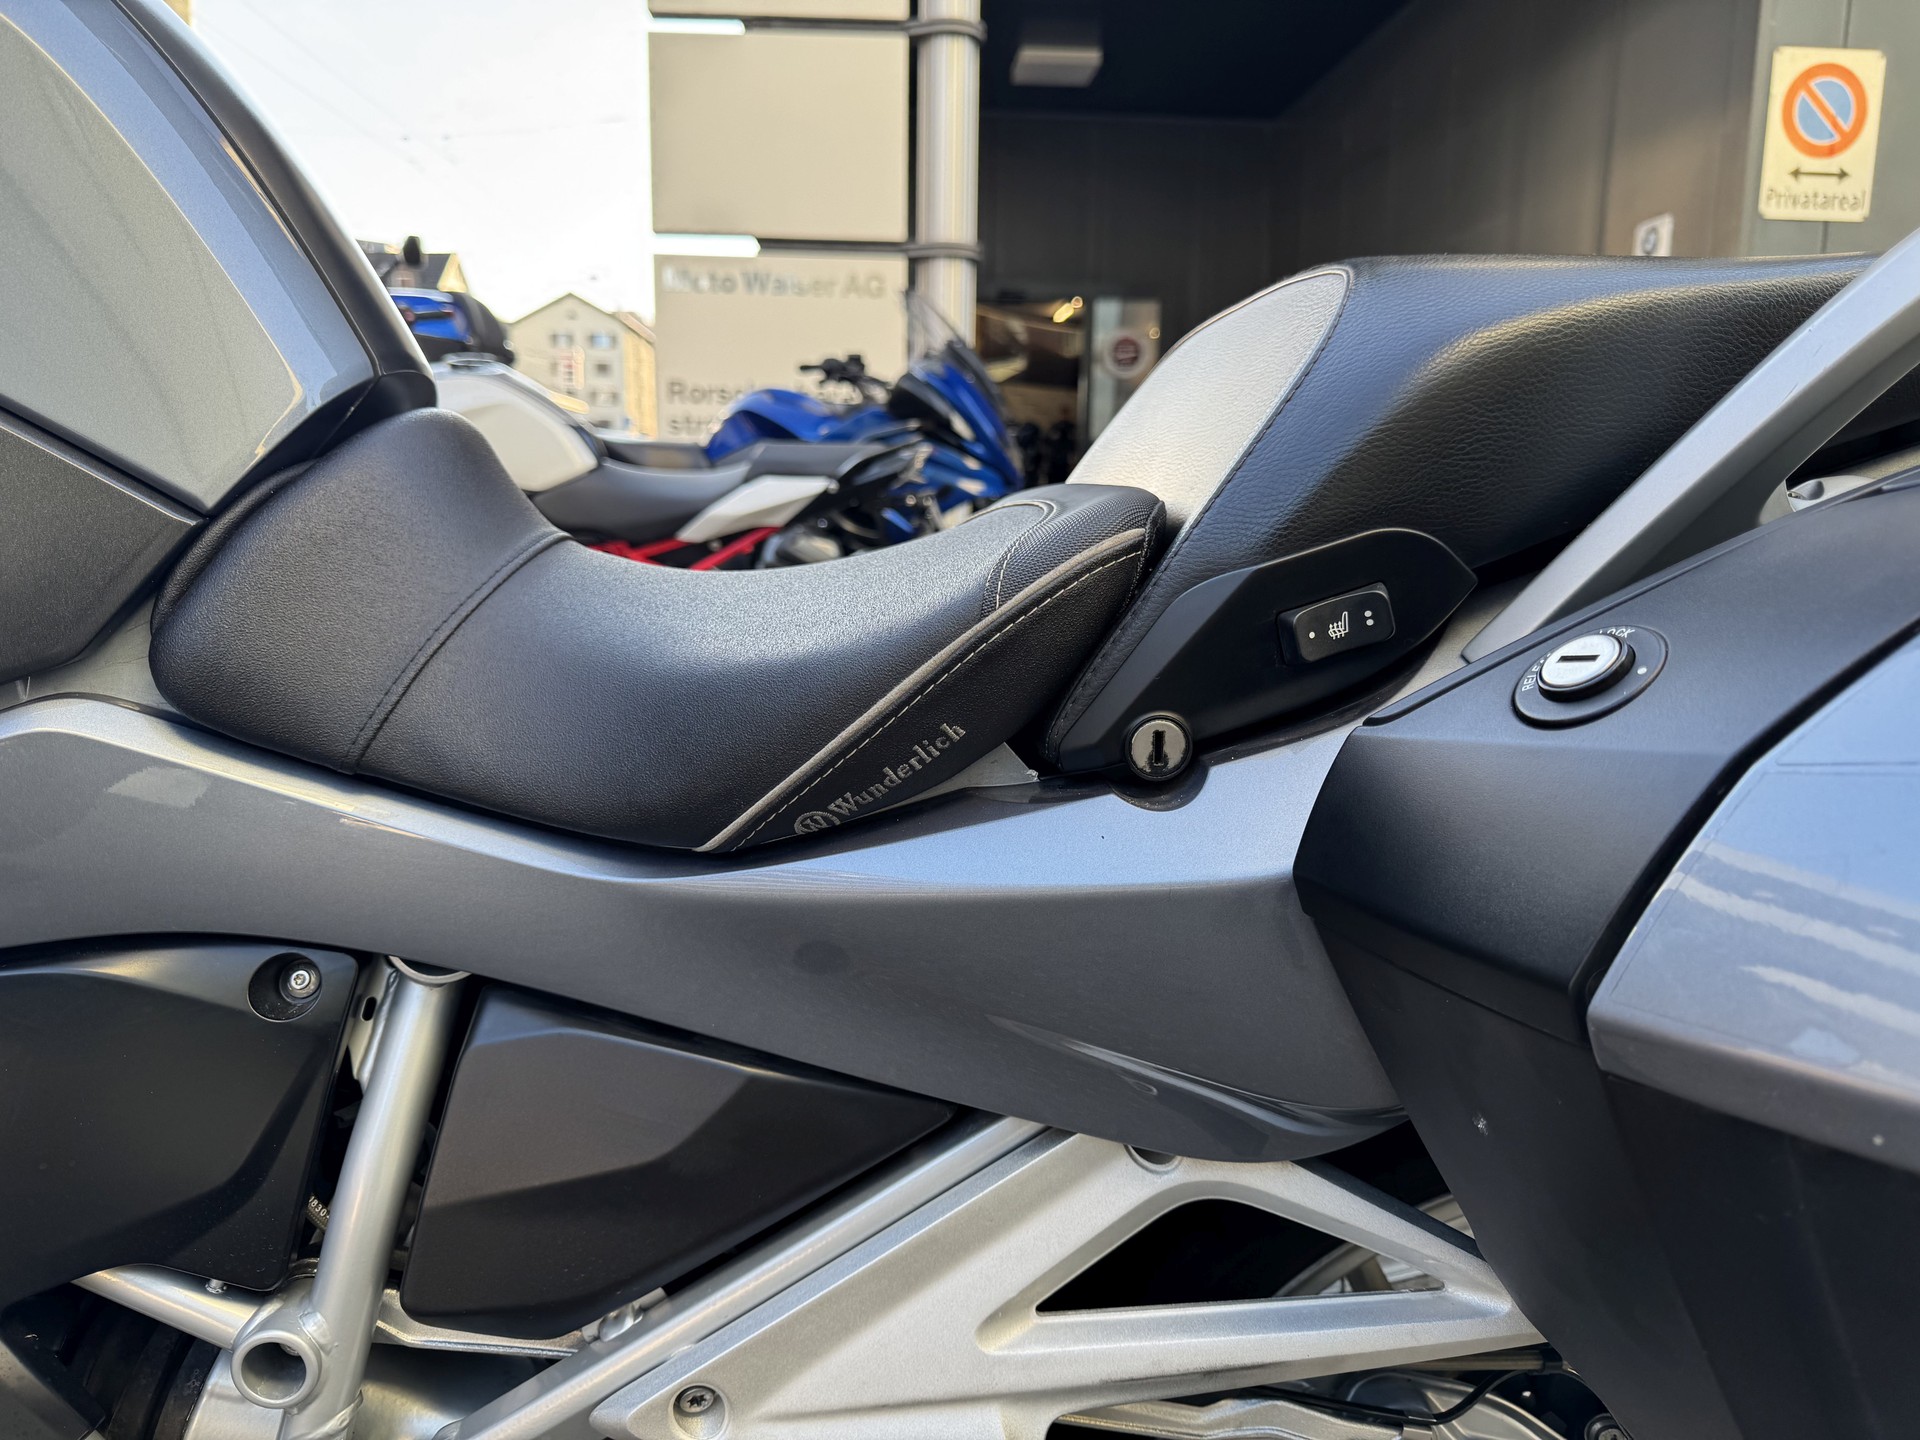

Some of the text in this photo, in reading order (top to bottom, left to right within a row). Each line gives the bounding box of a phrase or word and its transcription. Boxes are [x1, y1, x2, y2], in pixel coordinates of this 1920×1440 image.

[1765, 187, 1867, 212] Privatareal
[844, 271, 887, 298] AG
[827, 722, 967, 816] Wunderlich
